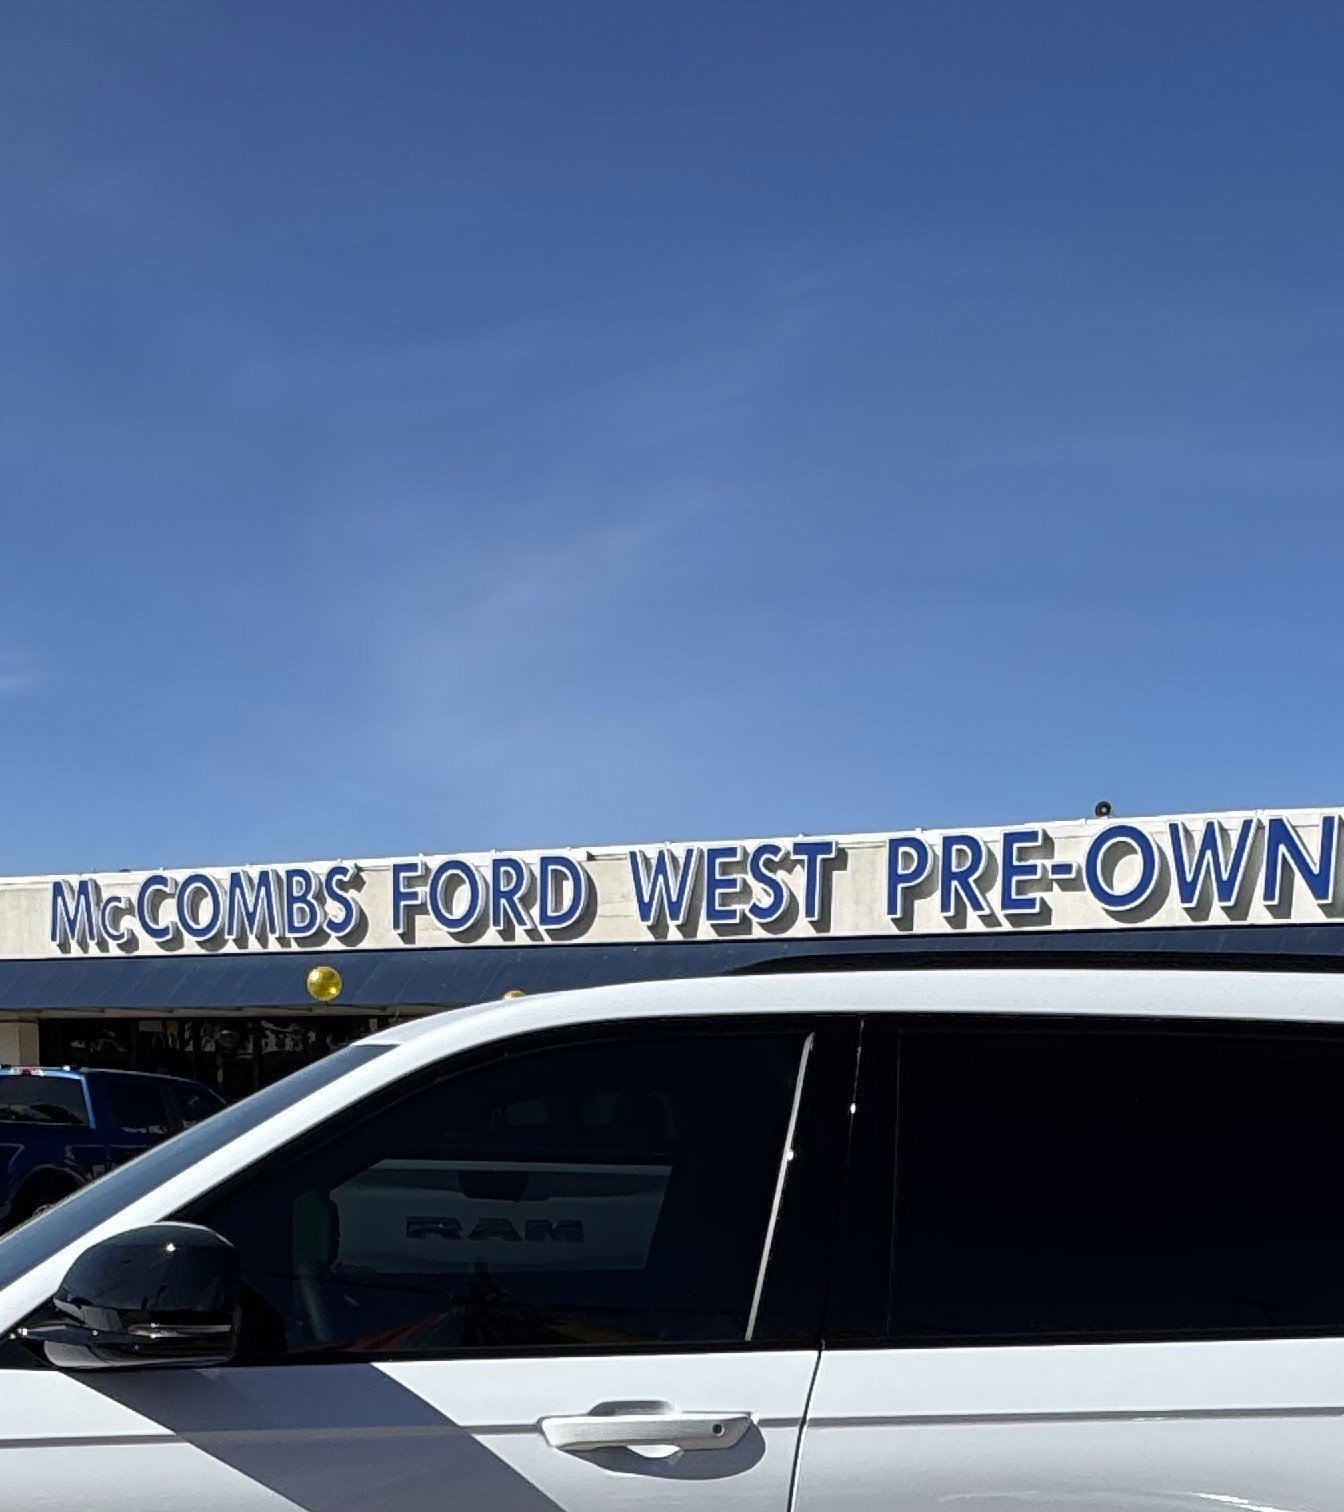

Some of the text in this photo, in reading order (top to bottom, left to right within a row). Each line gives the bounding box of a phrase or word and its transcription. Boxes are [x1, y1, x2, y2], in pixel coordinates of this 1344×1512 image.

[391, 852, 588, 934] FORD
[631, 839, 837, 924] WEST
[406, 1216, 584, 1242] RAM
